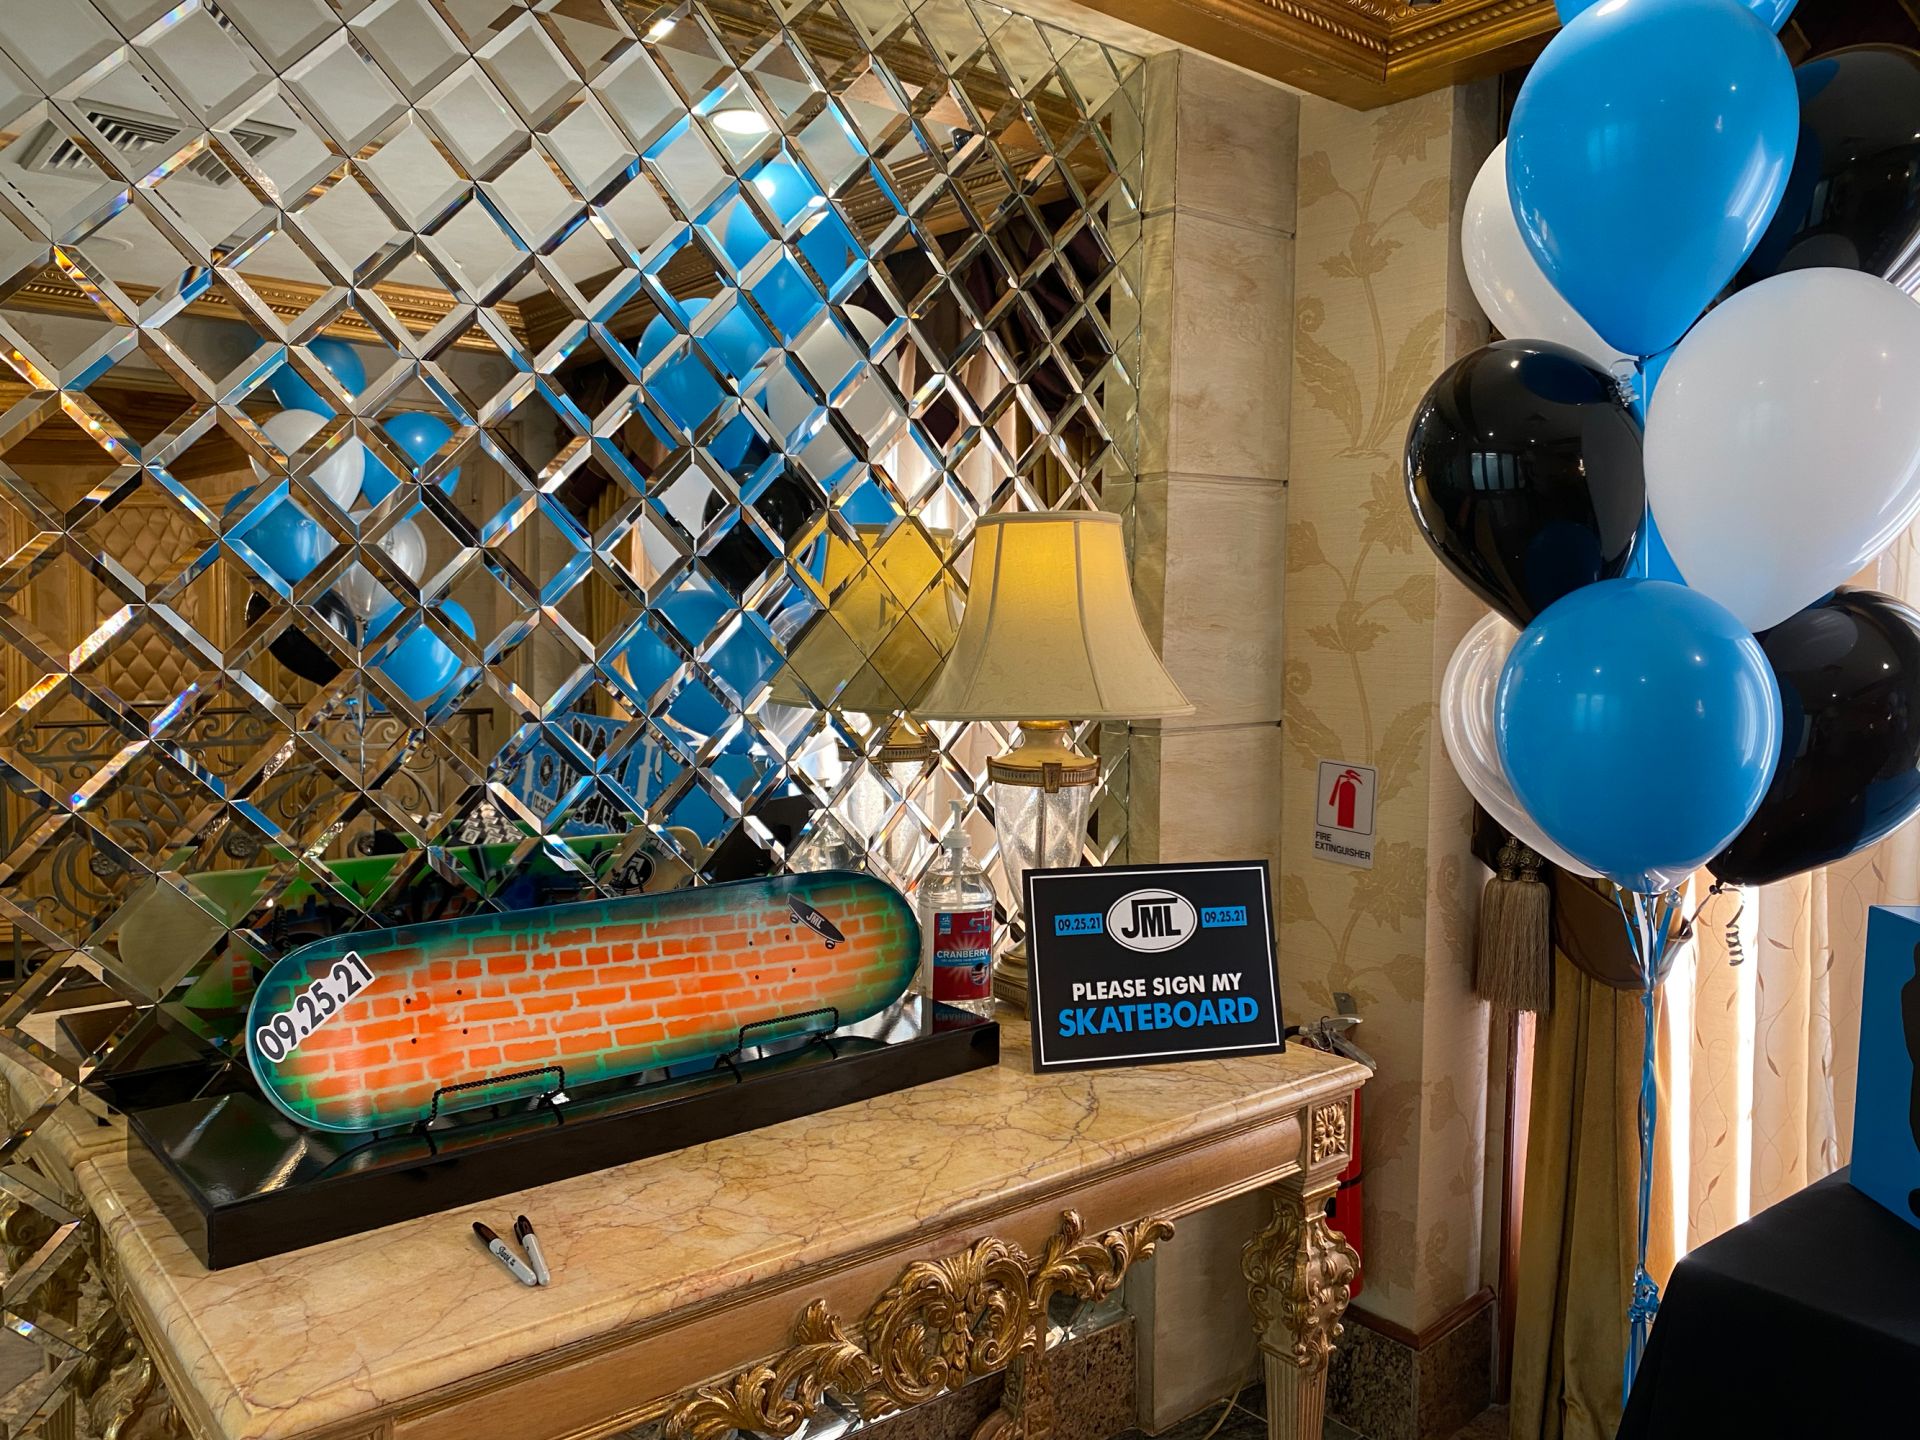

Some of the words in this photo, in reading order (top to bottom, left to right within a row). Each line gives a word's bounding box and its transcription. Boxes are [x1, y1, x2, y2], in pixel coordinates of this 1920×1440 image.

[1315, 831, 1333, 842] FIRE
[1315, 841, 1371, 860] EXTINGUISHER
[805, 911, 825, 929] JML
[1058, 917, 1101, 931] 09.25.21
[1121, 897, 1182, 939] JML
[1204, 909, 1245, 923] 09.25.21
[936, 947, 990, 959] CRANBERRY
[1072, 978, 1147, 1001] PLEASE
[1152, 974, 1205, 996] SIGN
[1212, 972, 1242, 992] MY
[258, 952, 373, 1060] 09.25.21
[1058, 996, 1259, 1038] SKATEBOARD
